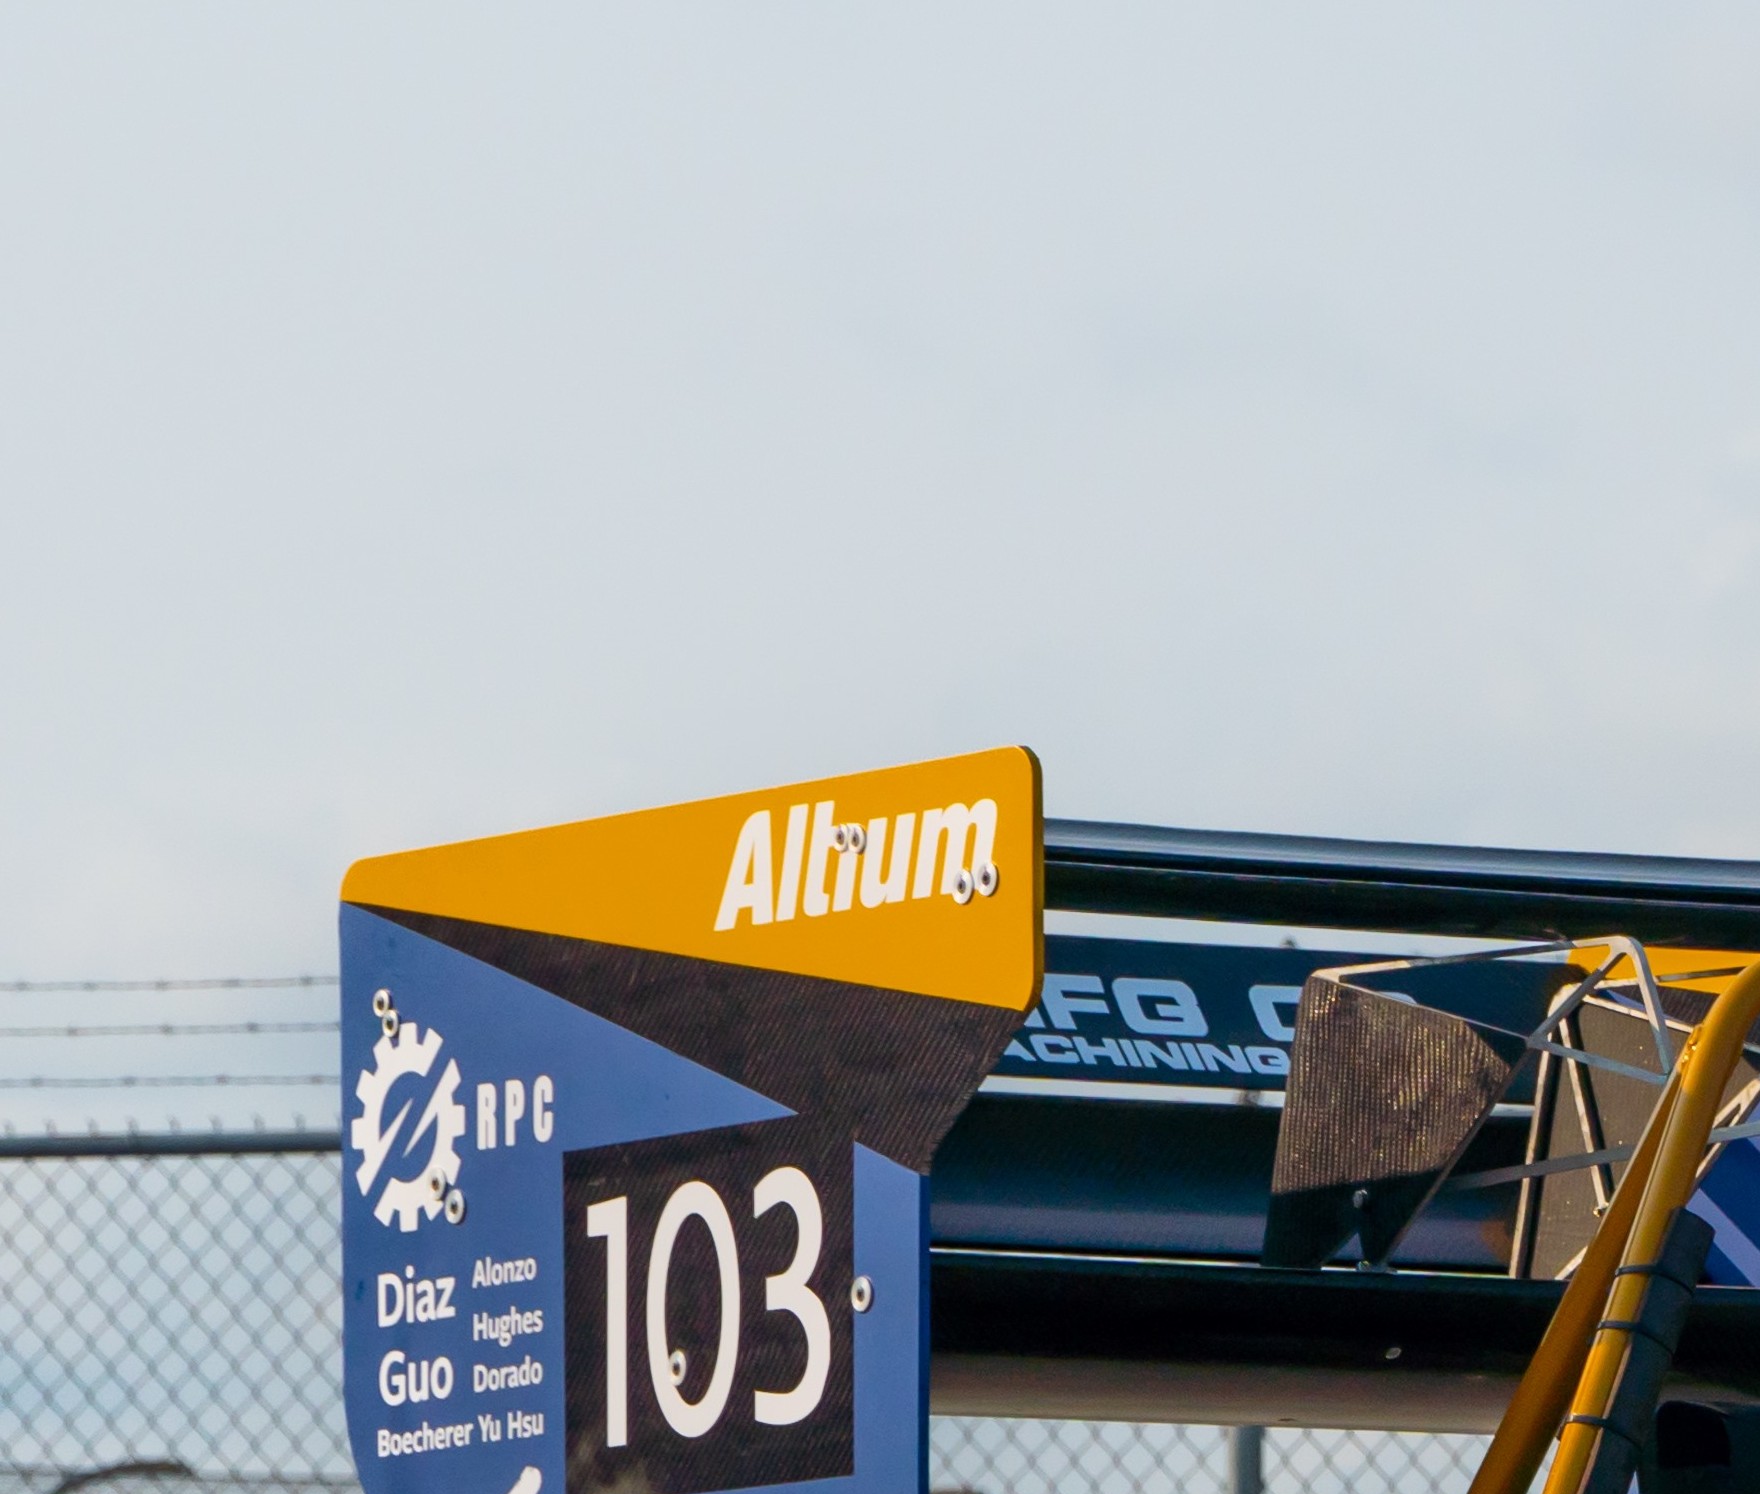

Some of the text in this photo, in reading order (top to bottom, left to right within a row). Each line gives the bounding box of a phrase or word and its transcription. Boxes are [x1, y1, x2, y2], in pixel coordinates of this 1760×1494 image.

[713, 798, 998, 932] Altium
[1003, 1033, 1291, 1076] ACHINING
[476, 1075, 555, 1150] RPC
[378, 1266, 456, 1327] Diaz
[472, 1257, 537, 1289] Alonzo
[473, 1307, 544, 1347] Hughes
[586, 1166, 831, 1449] 103
[379, 1351, 454, 1405] Guo
[473, 1358, 543, 1392] Dorado
[378, 1410, 544, 1457] Boecherer Yu Hsu
